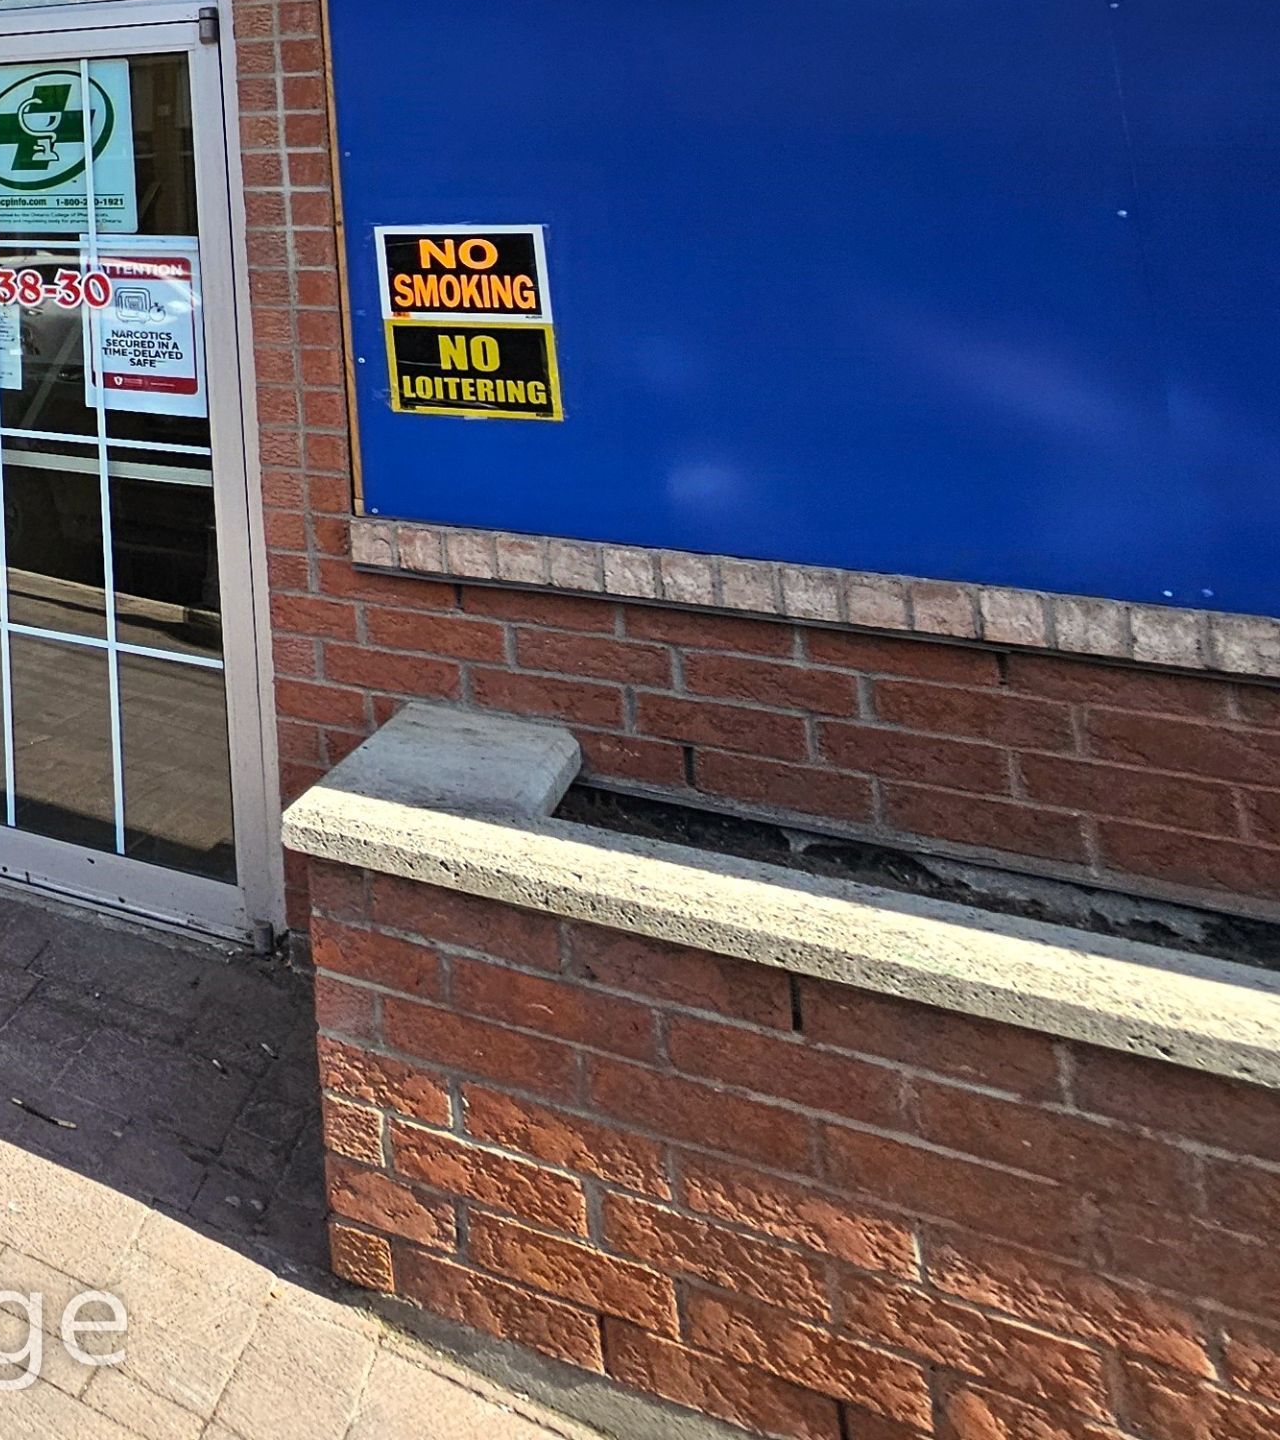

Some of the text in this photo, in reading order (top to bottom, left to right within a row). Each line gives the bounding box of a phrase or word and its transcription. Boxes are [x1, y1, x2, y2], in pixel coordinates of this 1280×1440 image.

[55, 198, 123, 206] 1-800-20-1921
[419, 239, 498, 269] NO
[394, 274, 536, 309] SMOKING
[111, 330, 172, 340] NARCOTICS
[106, 339, 180, 350] SECURED IN A
[102, 347, 183, 359] TIME-DELAYED
[438, 335, 500, 372] NO
[129, 358, 156, 368] SAFE
[402, 375, 548, 405] LOITERING
